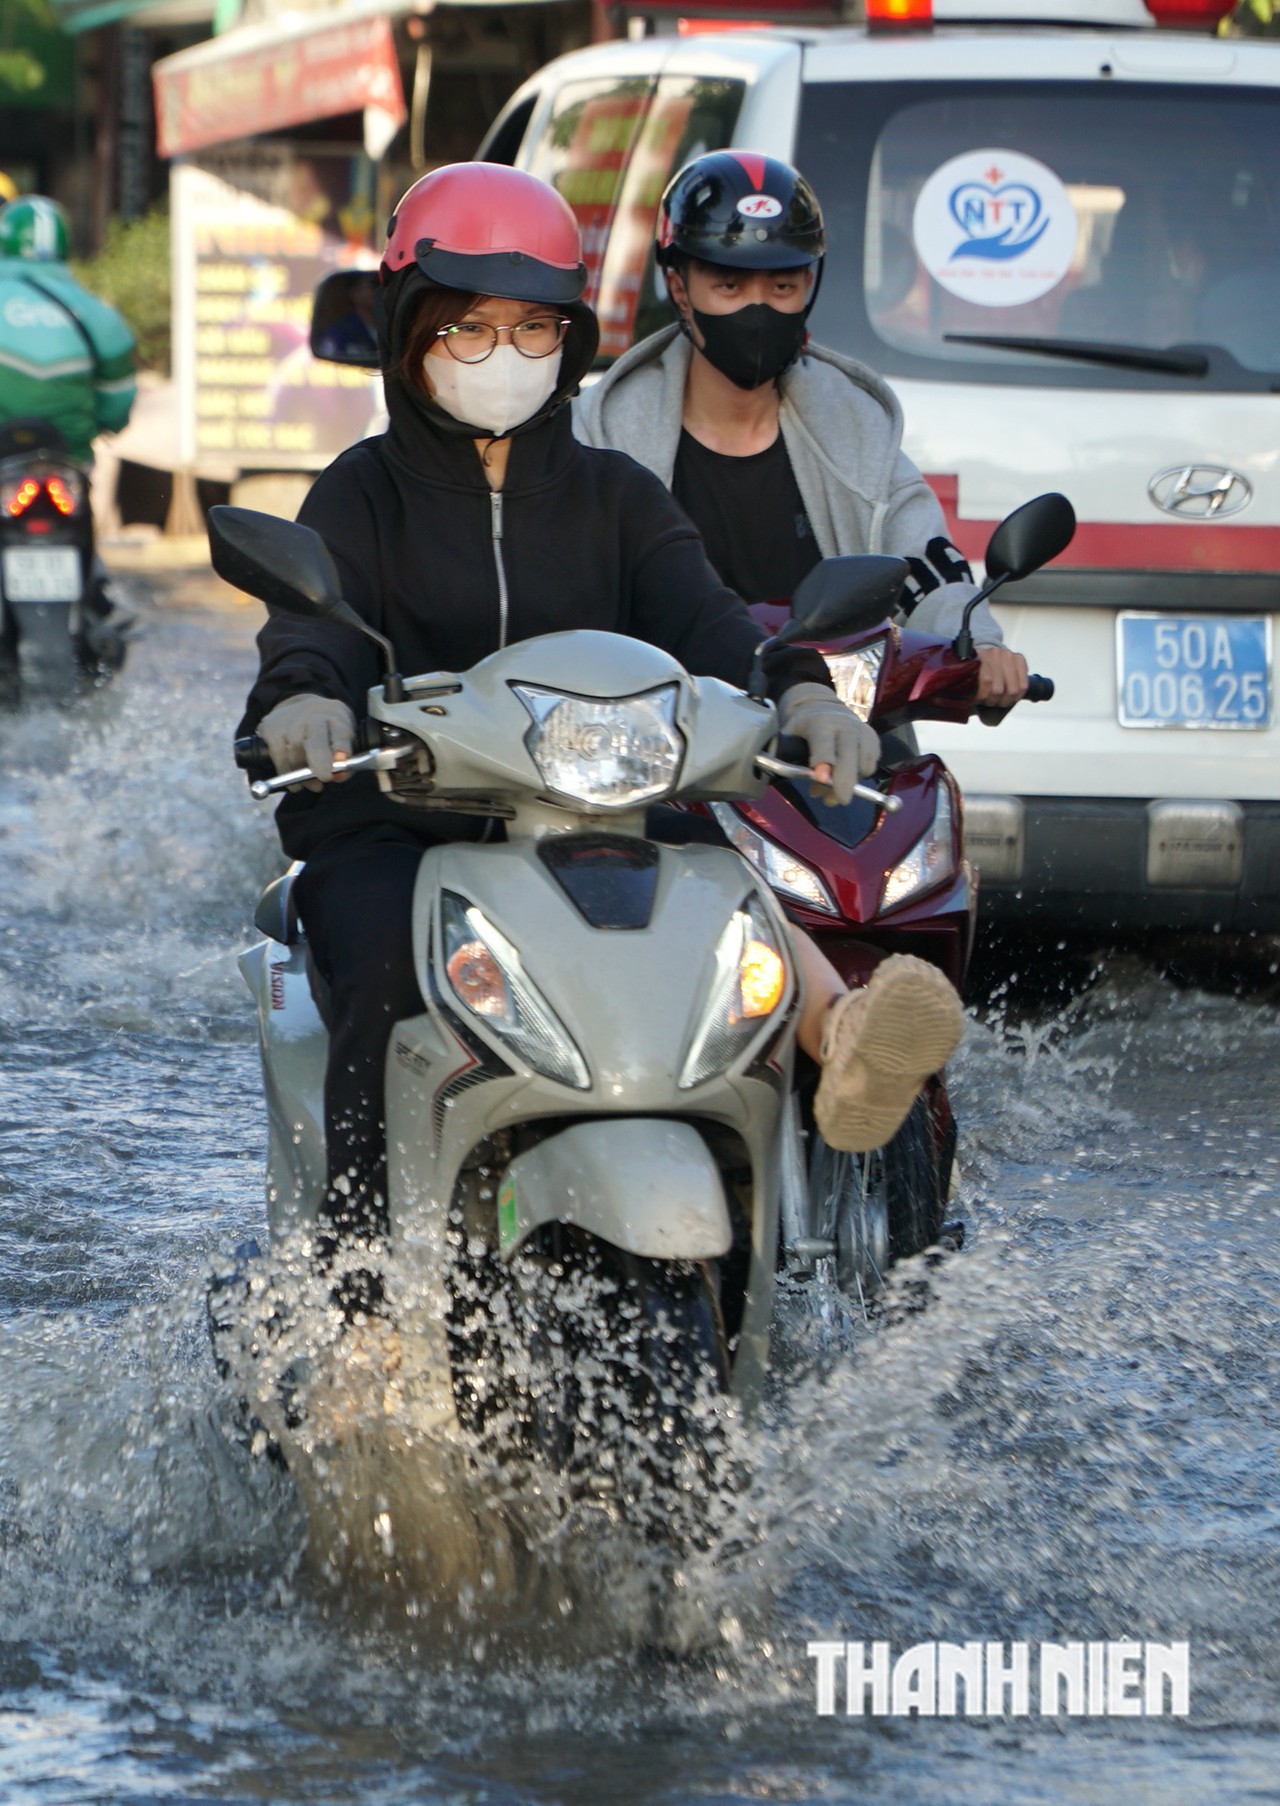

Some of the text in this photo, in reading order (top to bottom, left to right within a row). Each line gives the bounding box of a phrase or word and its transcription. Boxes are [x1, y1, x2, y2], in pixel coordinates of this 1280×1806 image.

[964, 199, 1026, 227] NTT
[1154, 622, 1234, 670] 50A
[270, 961, 286, 1010] VISION
